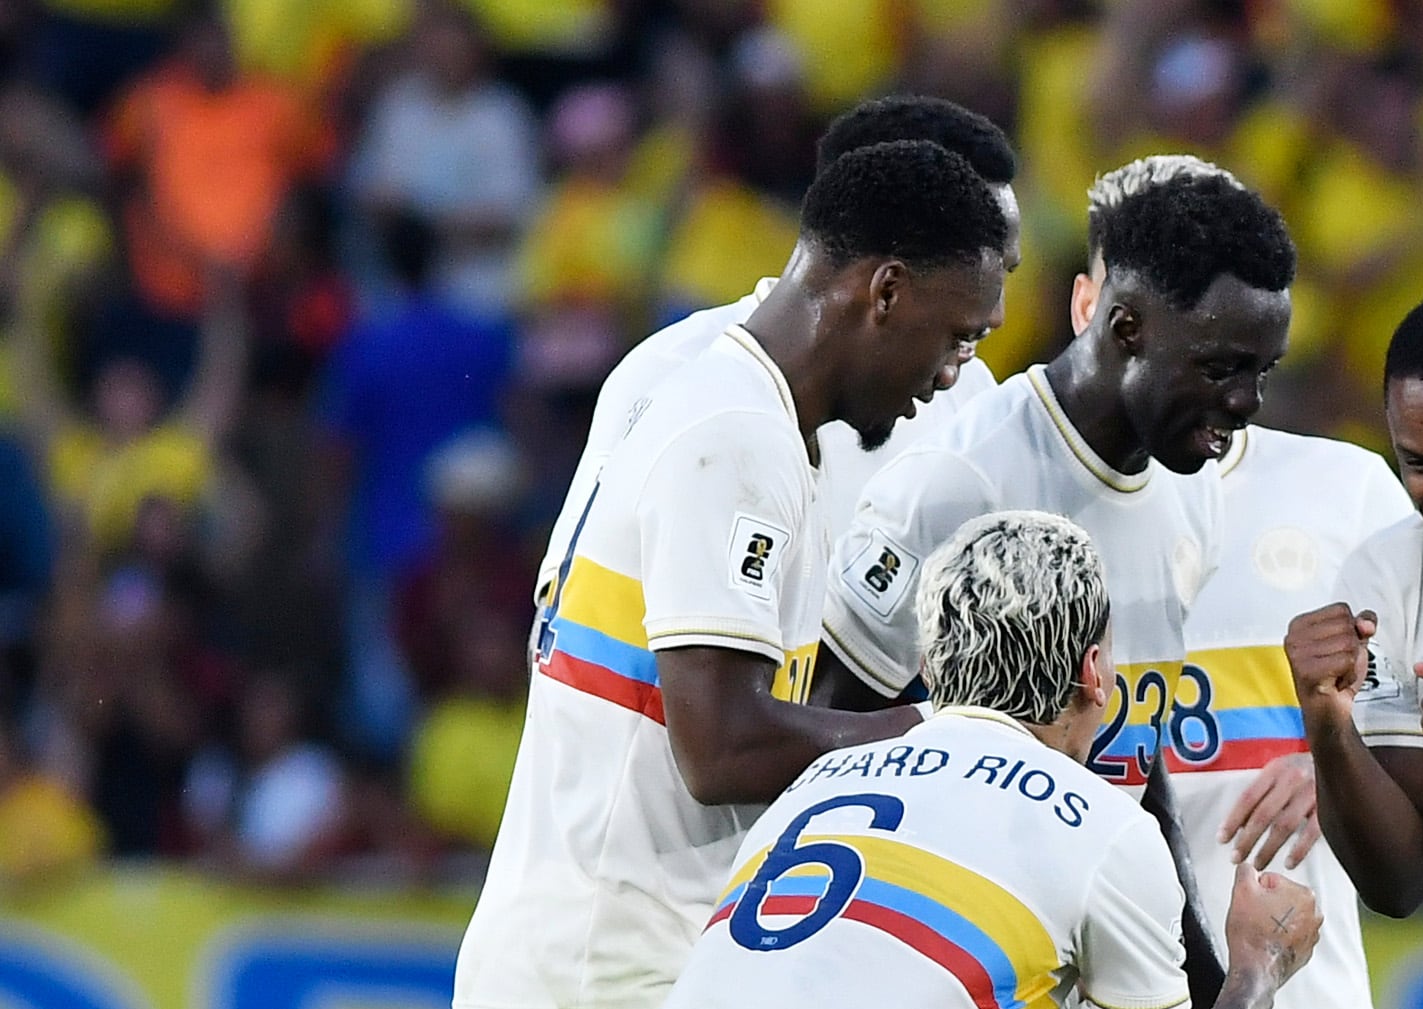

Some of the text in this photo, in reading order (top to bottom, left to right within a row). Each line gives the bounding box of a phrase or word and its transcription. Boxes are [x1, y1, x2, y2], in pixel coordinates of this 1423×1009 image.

[1085, 670, 1166, 778] 23
[1170, 664, 1219, 763] 8
[963, 755, 1090, 828] RIOS
[729, 793, 905, 952] 6
